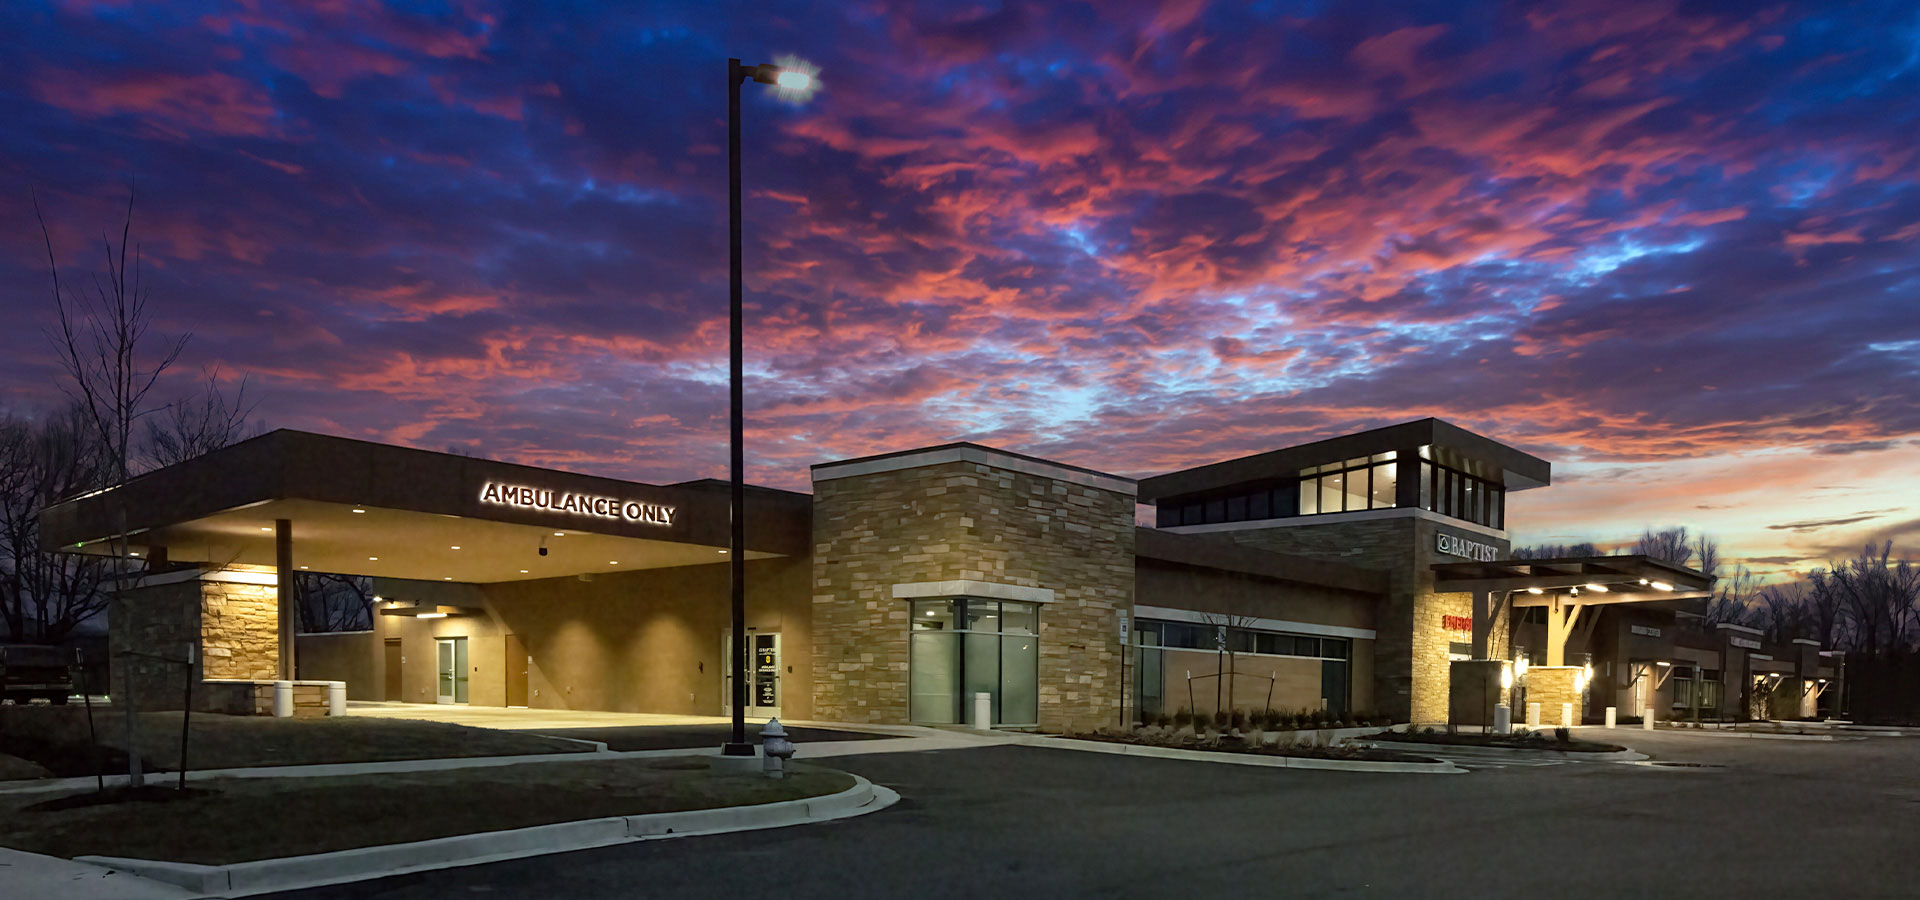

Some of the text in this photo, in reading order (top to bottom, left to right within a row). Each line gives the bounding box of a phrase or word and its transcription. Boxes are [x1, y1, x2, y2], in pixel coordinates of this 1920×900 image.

[482, 483, 677, 524] AMBULANCE ONLY
[1450, 536, 1498, 562] BAPTIST
